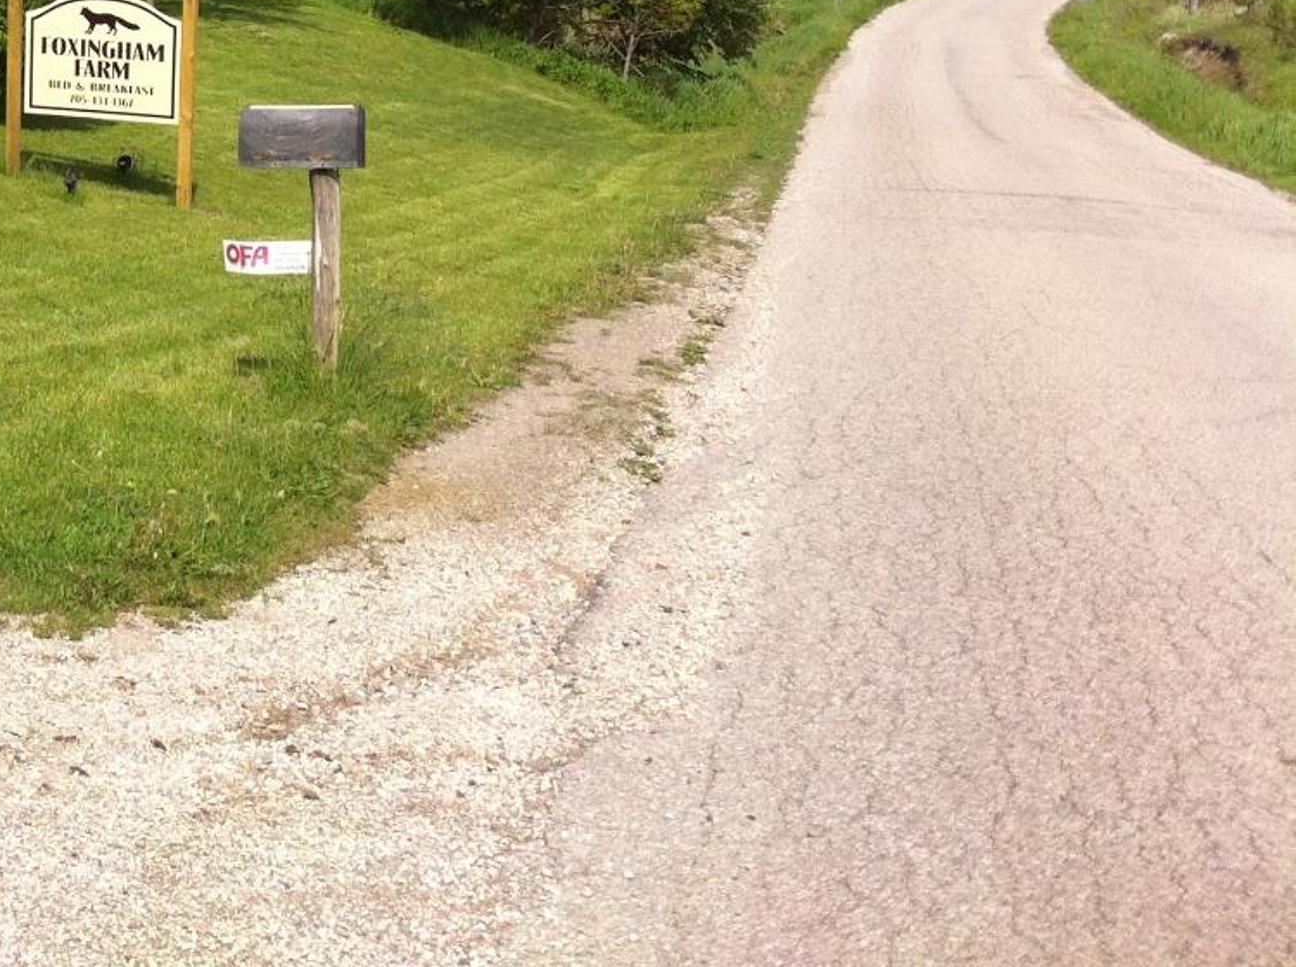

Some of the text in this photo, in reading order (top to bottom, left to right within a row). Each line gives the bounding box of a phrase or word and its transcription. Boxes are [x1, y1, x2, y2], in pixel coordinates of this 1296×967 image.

[40, 36, 165, 63] FOXINGHAM
[74, 58, 130, 80] FARM
[75, 81, 85, 92] &
[226, 243, 269, 269] OFA
